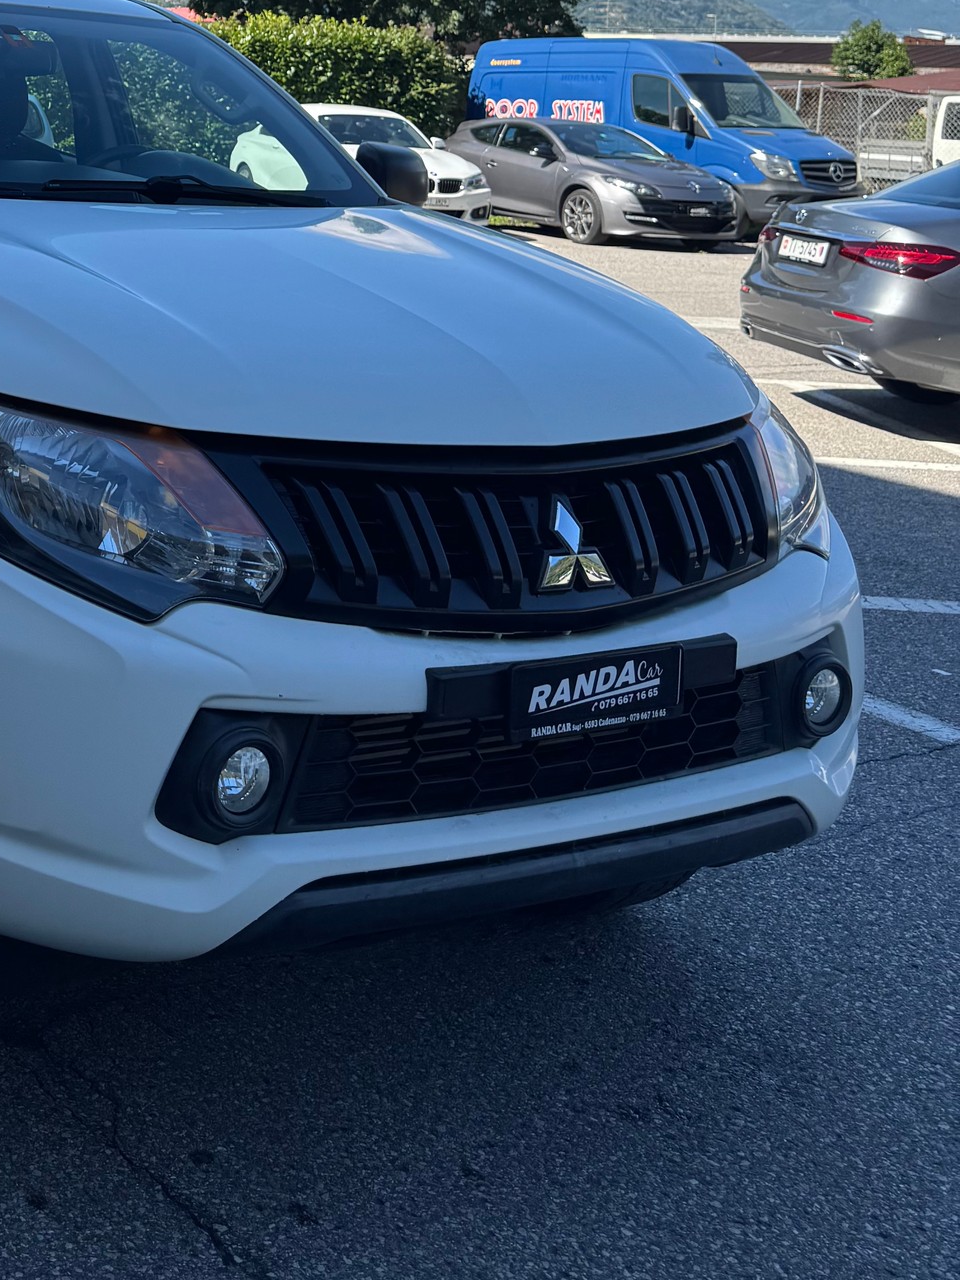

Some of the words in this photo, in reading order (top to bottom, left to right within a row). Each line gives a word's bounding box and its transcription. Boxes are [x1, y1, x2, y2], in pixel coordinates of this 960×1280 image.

[486, 98, 538, 119] DOOR
[551, 99, 604, 123] SYSTEM
[528, 660, 636, 713] RANDA
[637, 660, 663, 682] Car
[599, 698, 616, 710] 079
[618, 694, 634, 706] 667
[636, 690, 647, 701] 16
[648, 687, 659, 698] 65
[530, 725, 556, 738] RANDA
[557, 722, 572, 733] CAR
[630, 713, 640, 722] 079
[641, 711, 651, 720] 667
[652, 710, 659, 718] 16
[659, 708, 667, 717] 65
